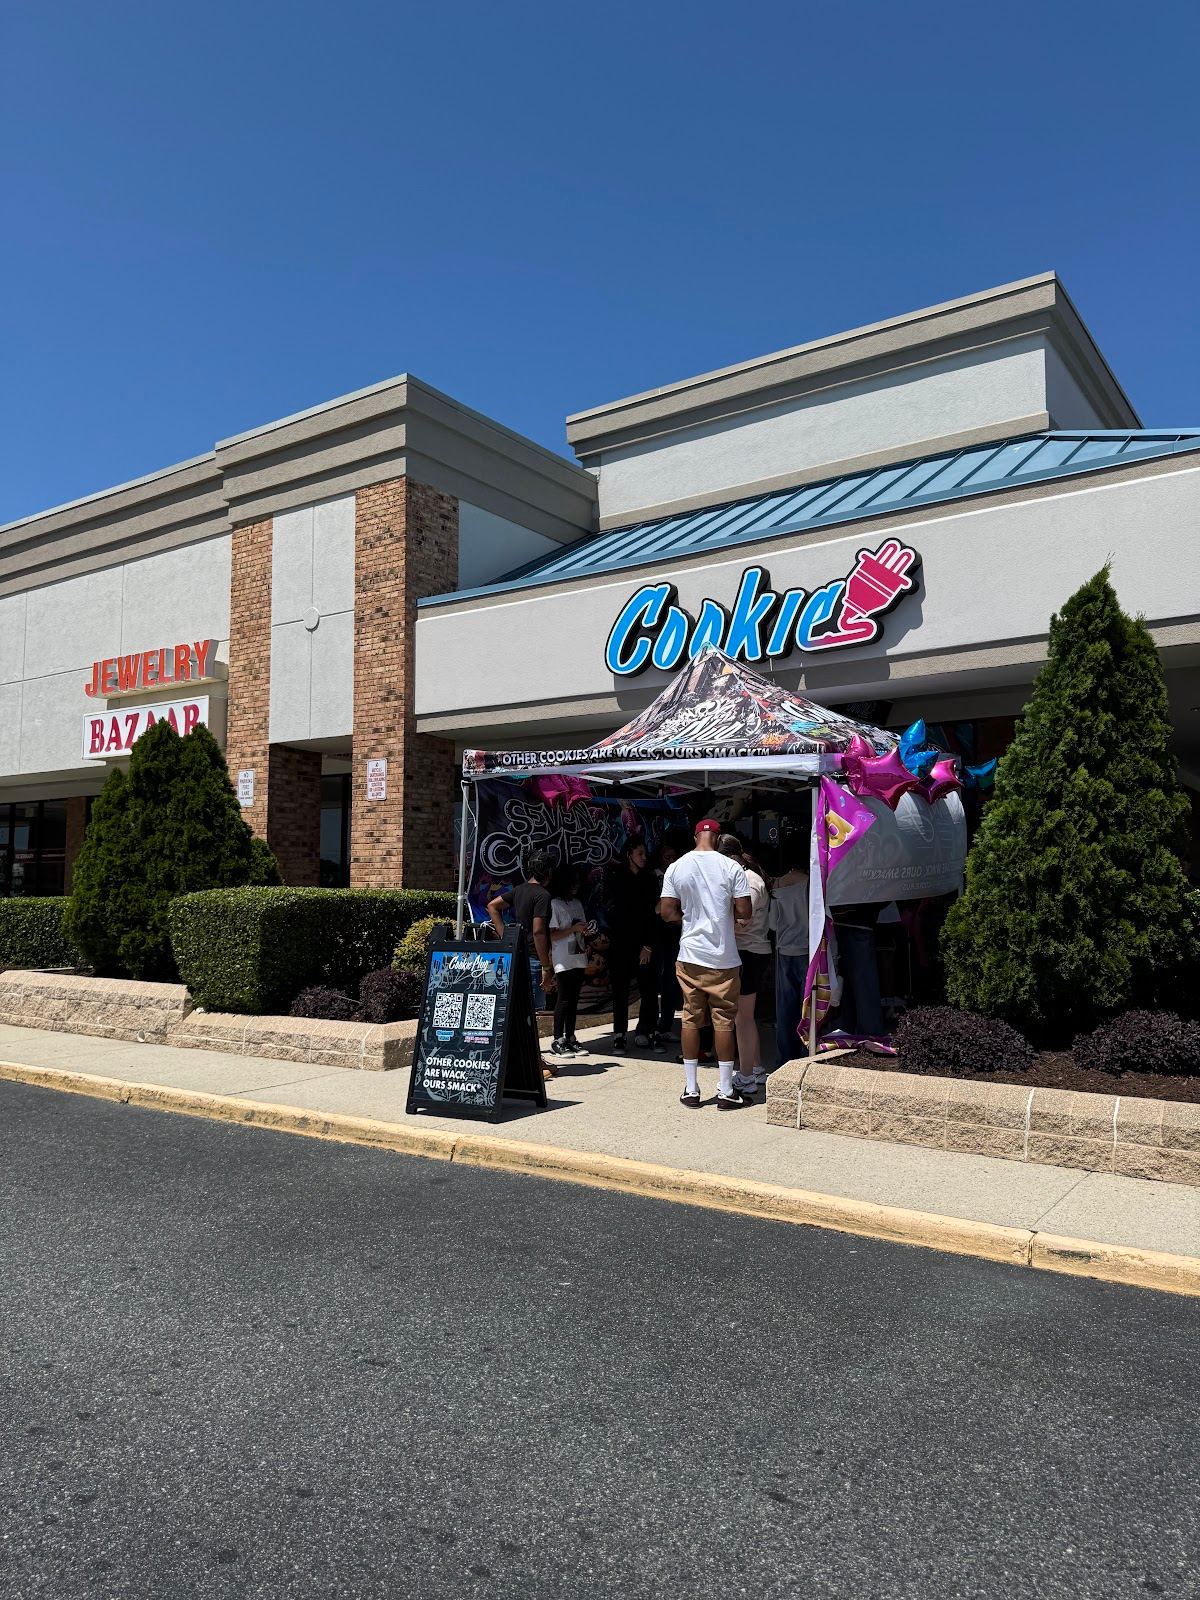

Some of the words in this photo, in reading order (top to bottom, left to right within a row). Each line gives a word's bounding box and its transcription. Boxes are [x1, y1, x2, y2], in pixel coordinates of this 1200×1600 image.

[604, 565, 850, 677] Cookie
[85, 639, 214, 698] JEWELRY
[502, 753, 537, 766] OTHER
[539, 749, 588, 764] COOKIES
[590, 747, 613, 759] ARE
[616, 745, 660, 760] WACK,
[663, 747, 701, 759] OURS
[504, 798, 600, 838] SEVEN
[426, 1056, 452, 1068] OTHER
[453, 1058, 491, 1071] COOKIES
[423, 1079, 446, 1090] OURS
[424, 1068, 440, 1078] ARE
[441, 1069, 468, 1081] WACK,
